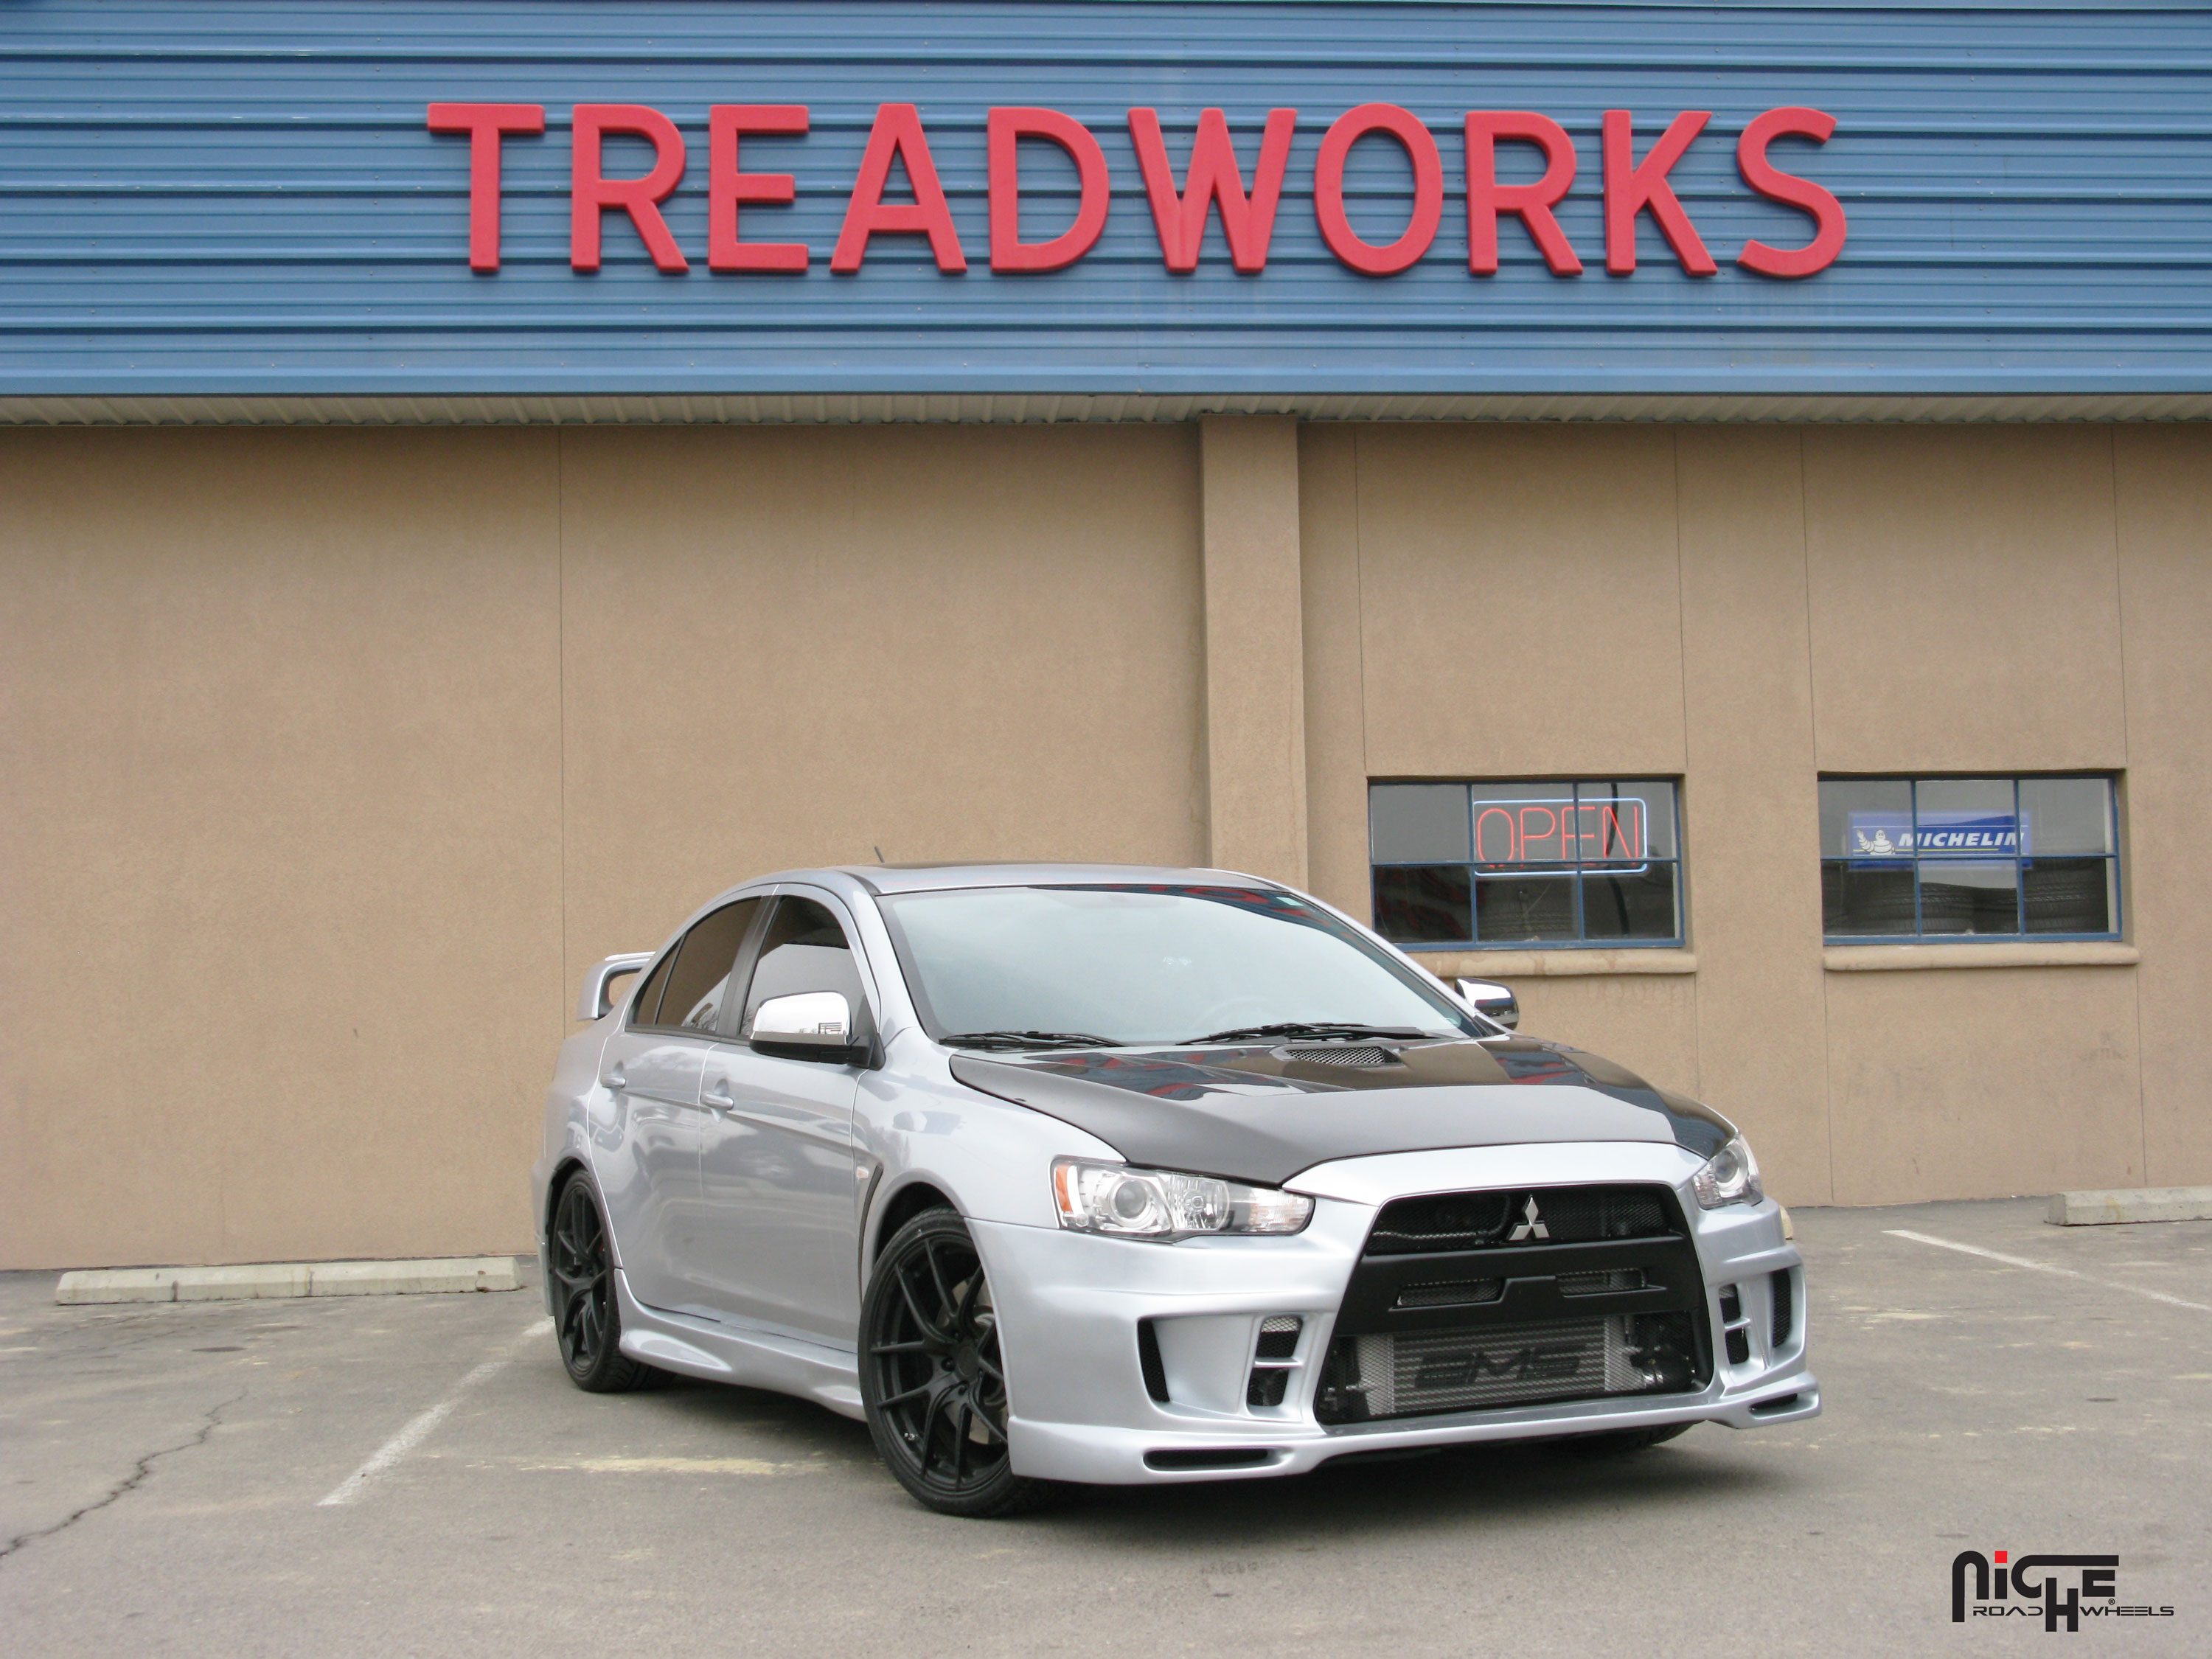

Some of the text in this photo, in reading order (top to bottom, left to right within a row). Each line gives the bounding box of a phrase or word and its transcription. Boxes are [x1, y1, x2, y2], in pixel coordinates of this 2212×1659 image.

[426, 102, 1847, 279] TREADWORKS
[1477, 806, 1639, 868] OPEN
[1899, 832, 2024, 846] MICHELIN
